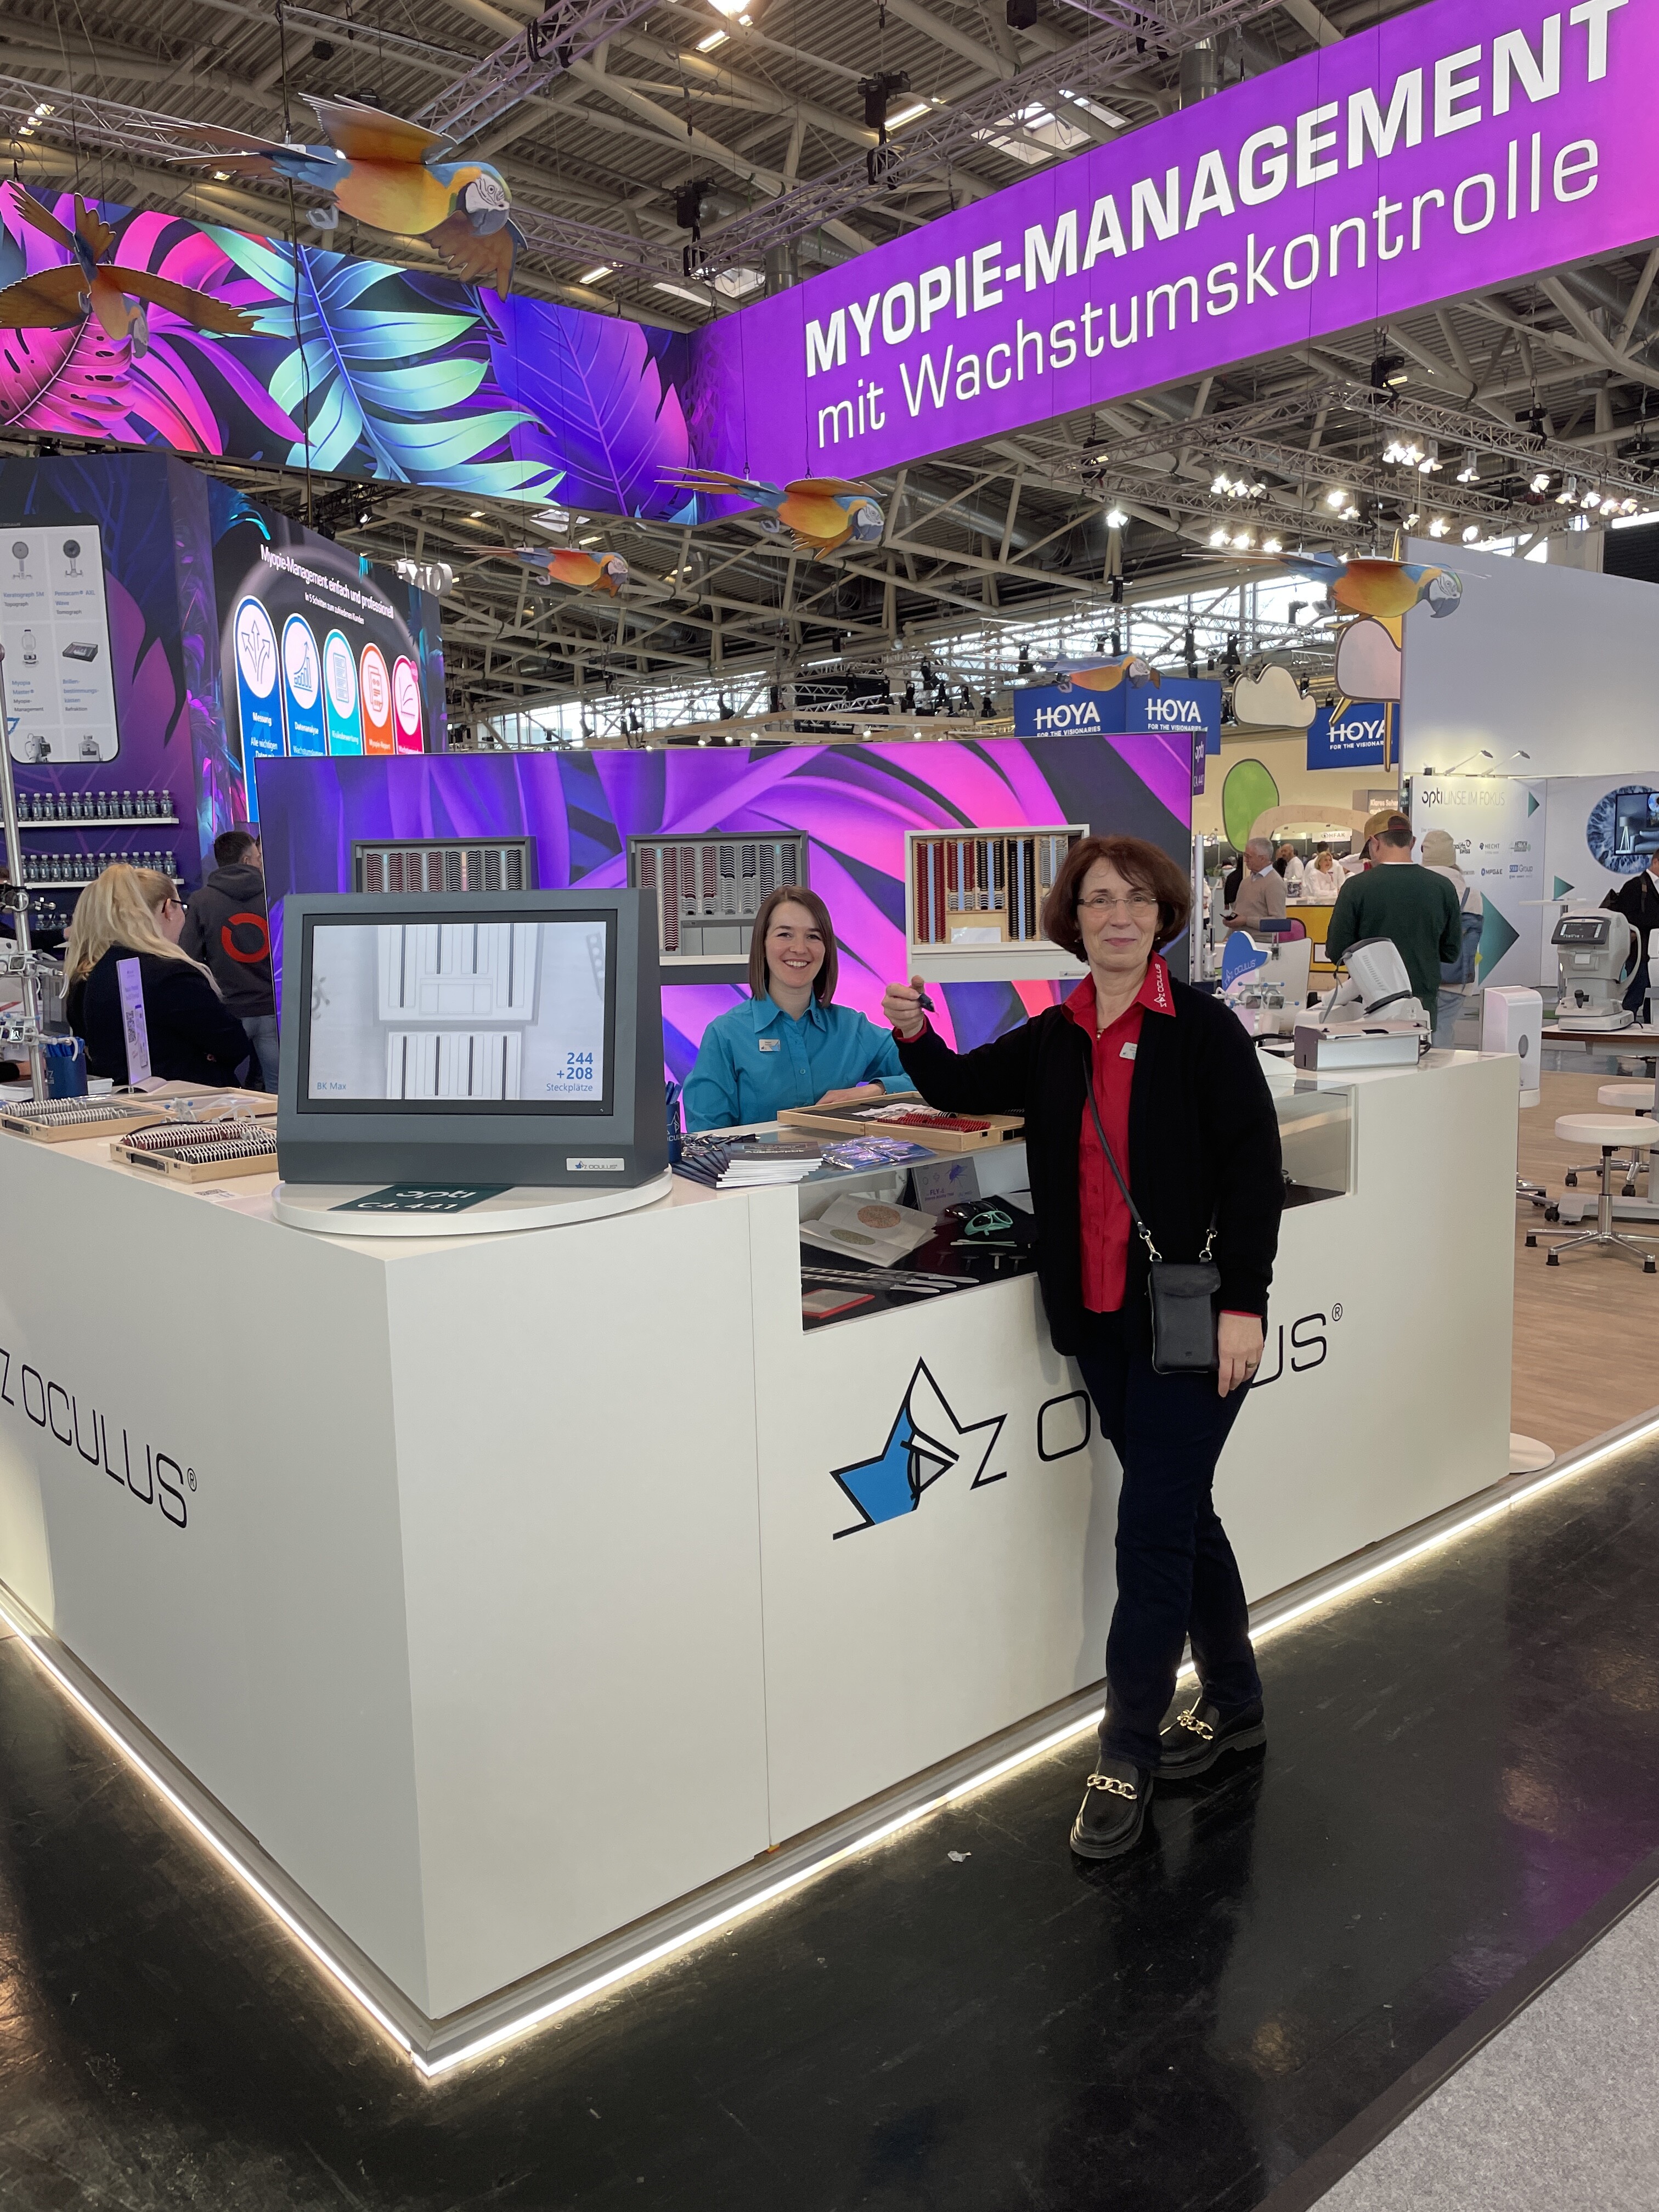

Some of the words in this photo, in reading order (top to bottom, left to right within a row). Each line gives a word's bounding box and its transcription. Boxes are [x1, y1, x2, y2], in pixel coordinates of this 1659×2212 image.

[806, 0, 1629, 377] MYOPIE-MANAGEMENT
[819, 379, 885, 448] mit
[899, 131, 1598, 417] Wachstumskontrolle
[261, 544, 329, 589] Myopie-Management
[329, 578, 349, 599] einfach
[350, 590, 361, 604] und
[361, 595, 394, 619] professionell
[1032, 701, 1101, 730] HOYA
[1144, 698, 1201, 723] HOYA
[252, 712, 272, 727] Messung
[1063, 725, 1101, 736] VISIONARIES
[1422, 787, 1443, 808] opti
[1443, 791, 1466, 805] LINSE
[1468, 791, 1477, 805] IM
[1480, 791, 1505, 806] FOKUS
[1519, 864, 1533, 872] Group
[1154, 963, 1165, 992] OCULUS
[567, 1052, 593, 1064] 244
[557, 1067, 593, 1080] +208
[317, 1082, 328, 1090] BK
[330, 1082, 347, 1090] Max
[546, 1083, 593, 1093] Steckplätze
[396, 1190, 476, 1199] opti
[357, 1201, 459, 1210] C4.441
